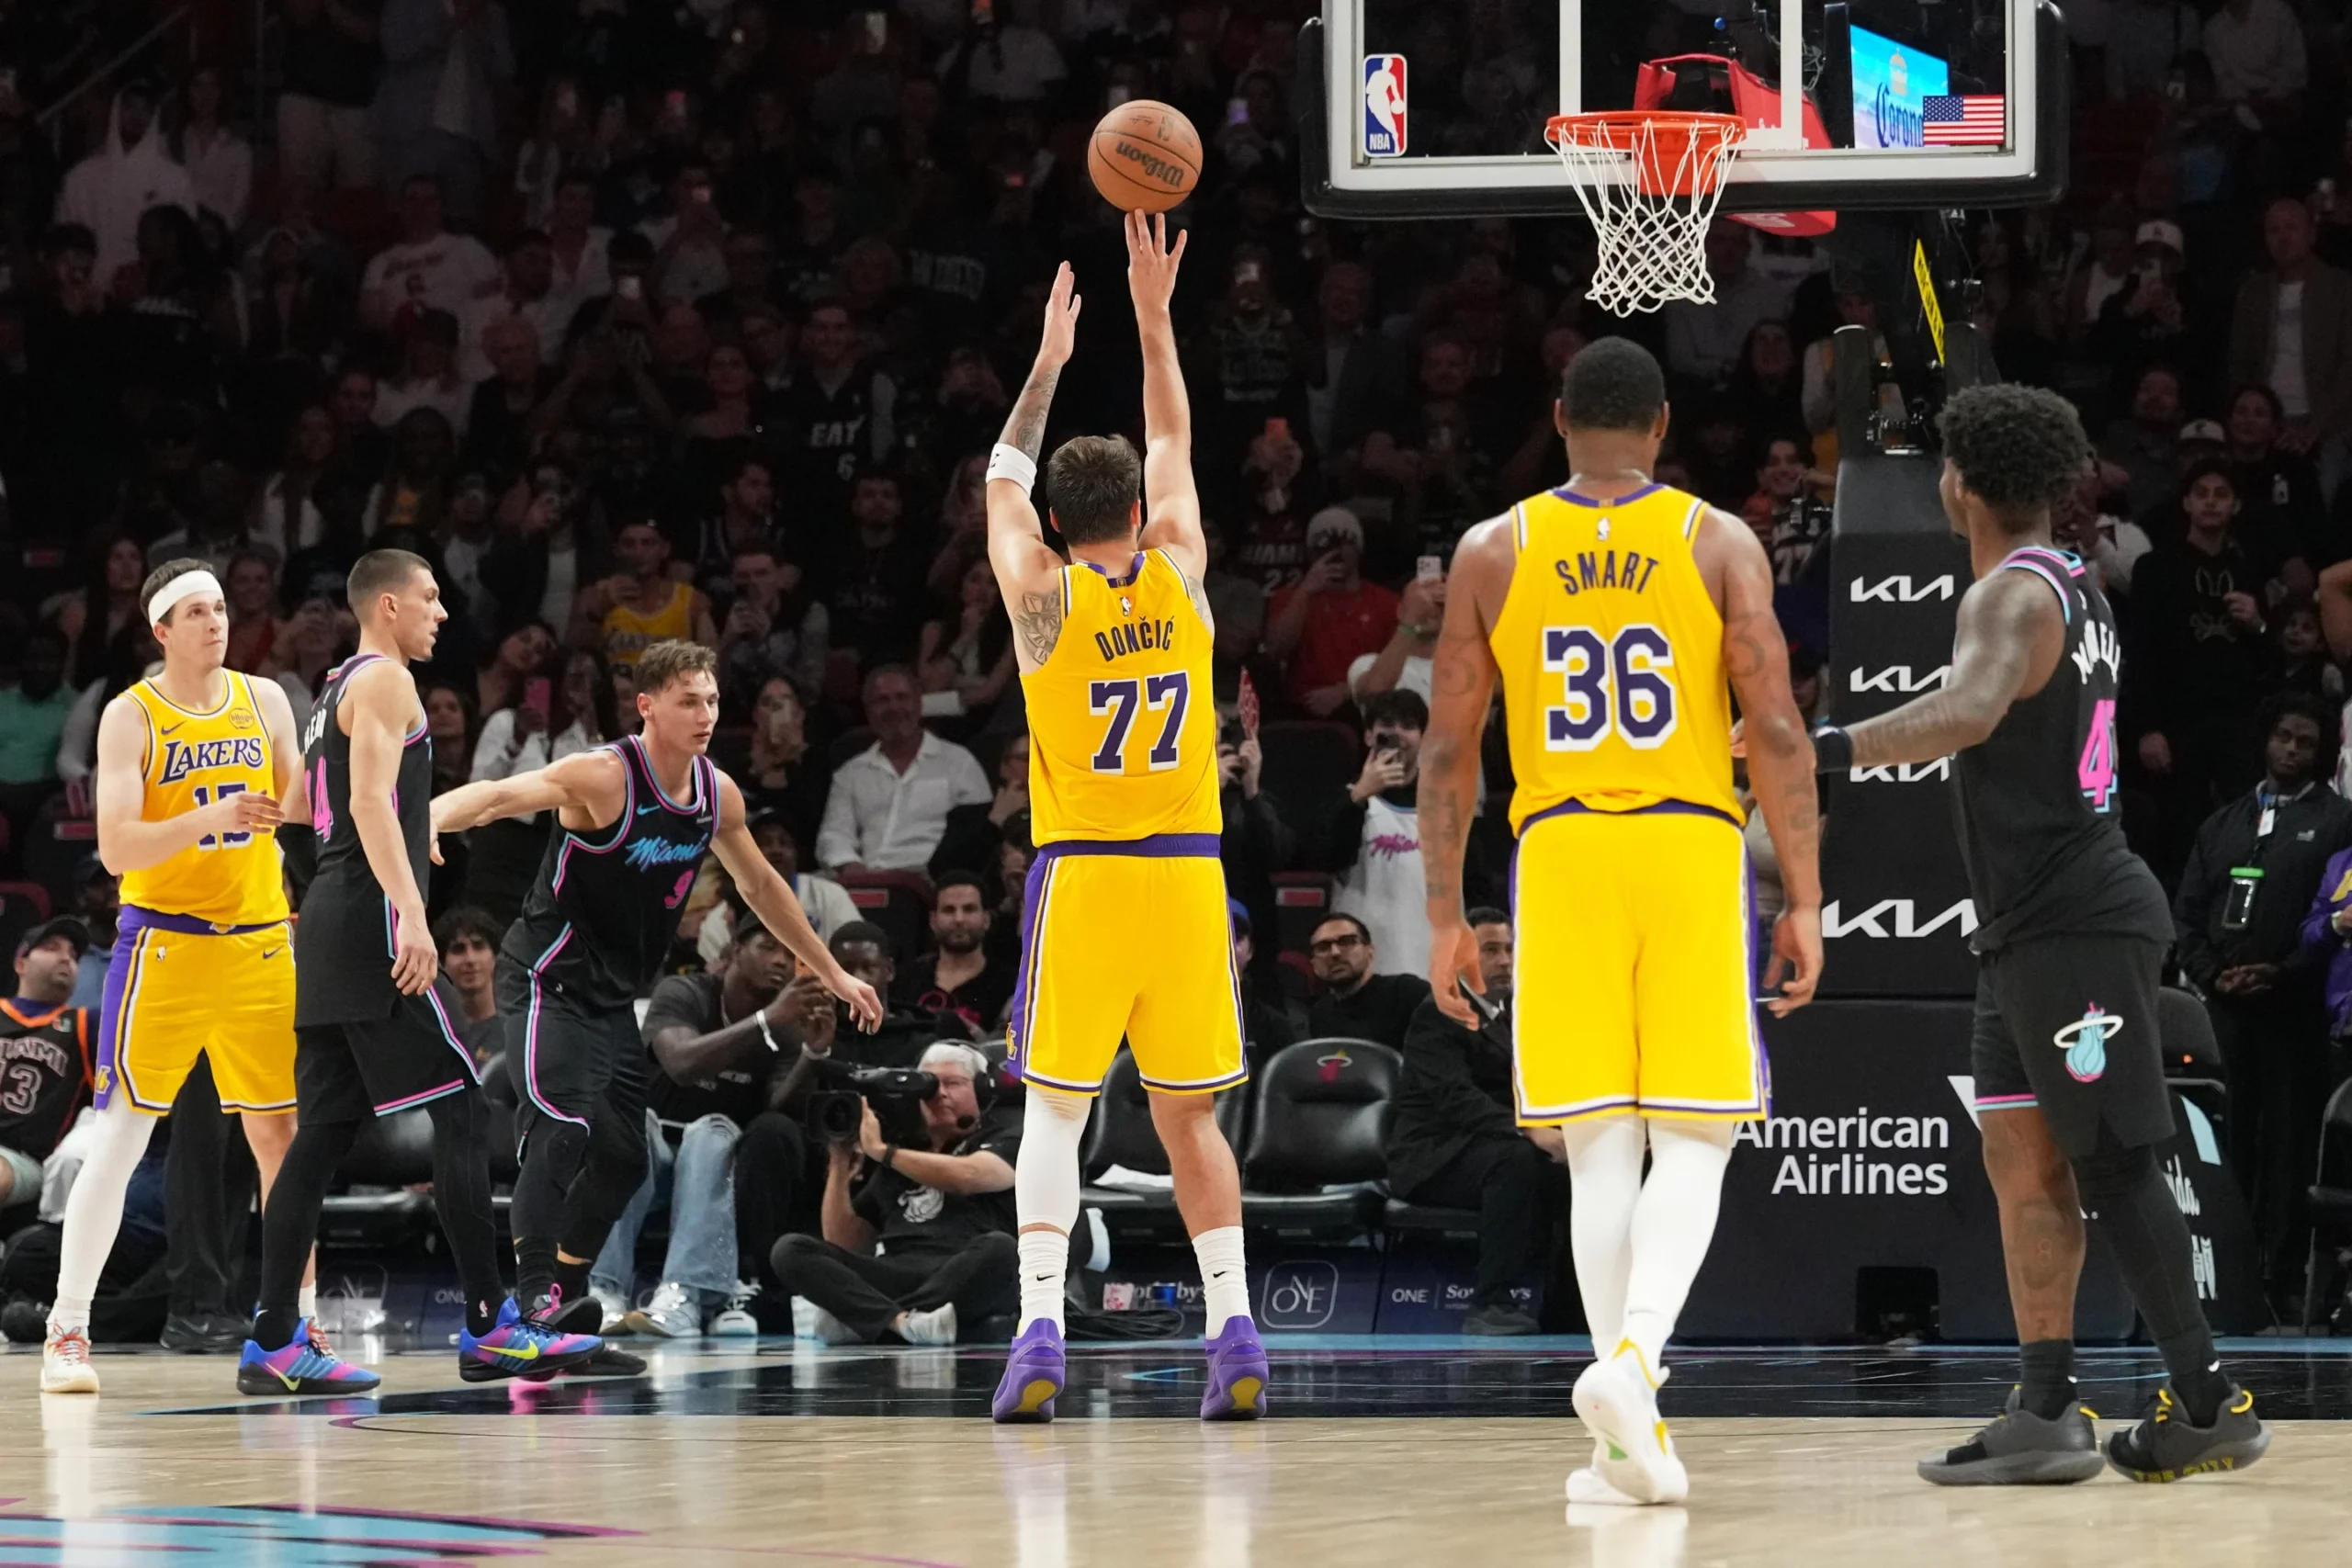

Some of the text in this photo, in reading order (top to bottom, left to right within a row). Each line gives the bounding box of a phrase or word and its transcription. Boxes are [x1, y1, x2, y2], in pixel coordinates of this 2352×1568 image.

[1369, 132, 1390, 151] NBA
[1116, 141, 1184, 188] Wilson
[1555, 550, 1659, 596] SMART
[1850, 574, 1955, 603] KIA
[1094, 615, 1175, 662] DONČIĆ
[1542, 623, 1678, 752] 36
[1088, 670, 1192, 776] 77
[157, 738, 265, 785] LAKERS
[625, 832, 709, 874] Miami
[663, 868, 695, 909] 9
[1732, 1107, 1949, 1148] American
[1771, 1154, 1949, 1195] Airlines
[1391, 1288, 1430, 1303] ONE
